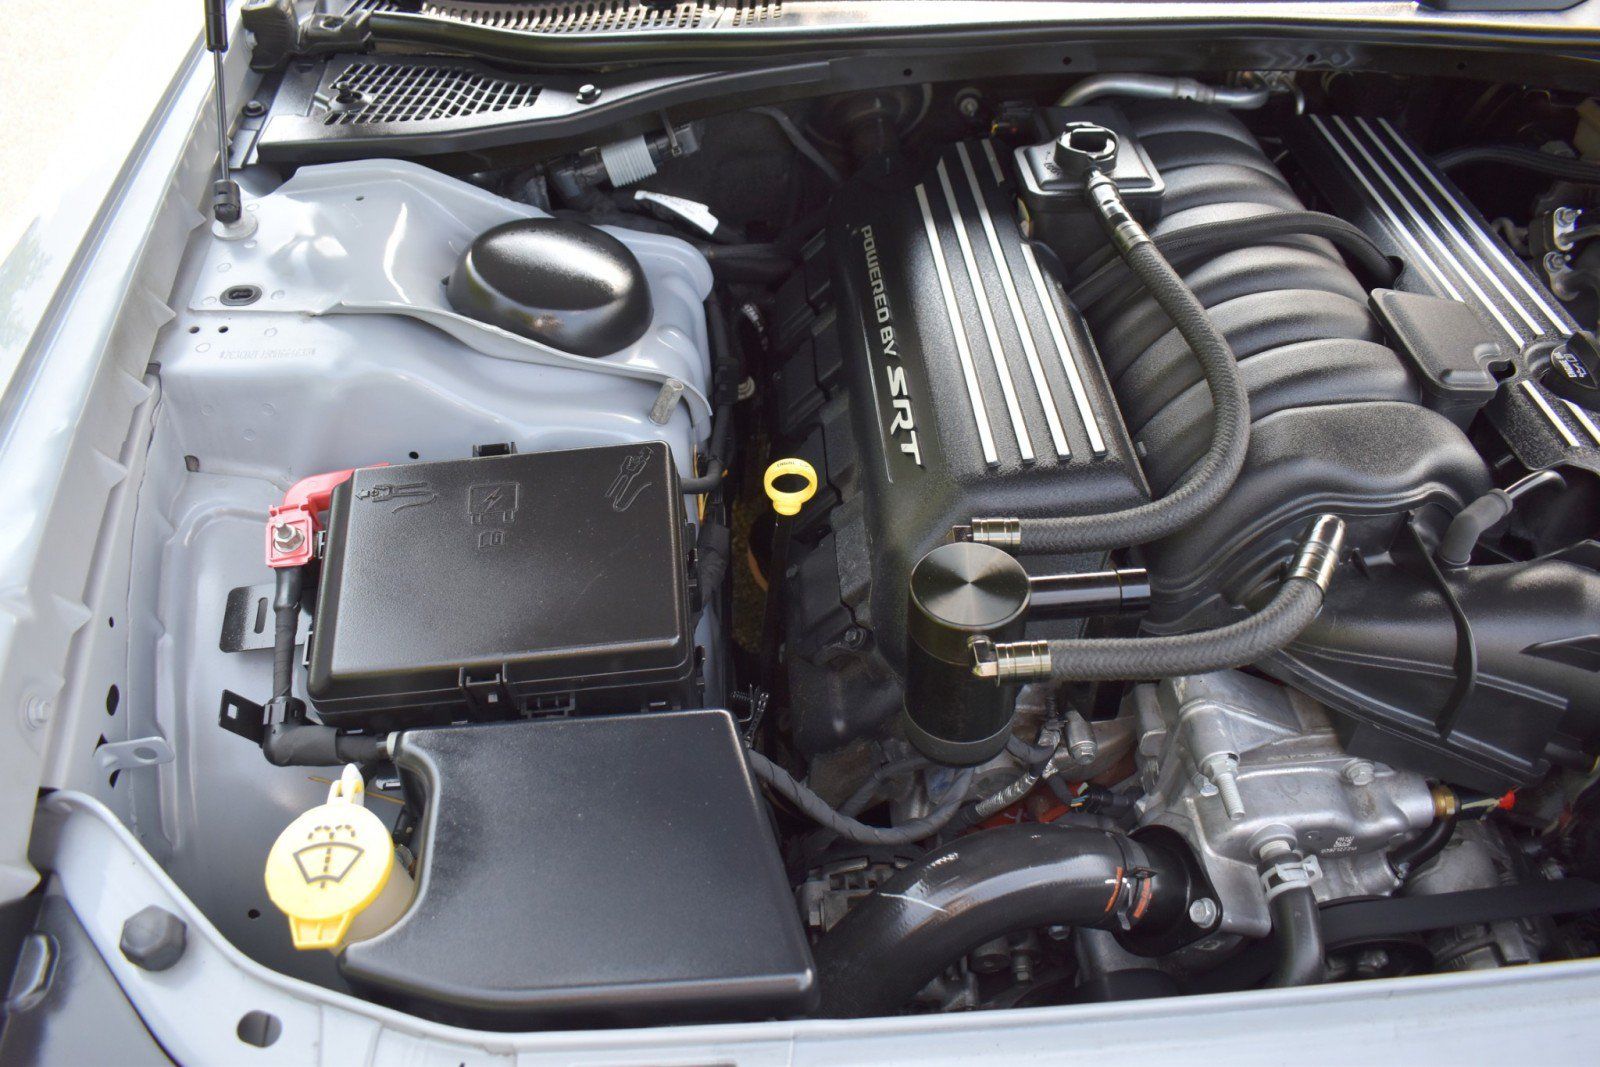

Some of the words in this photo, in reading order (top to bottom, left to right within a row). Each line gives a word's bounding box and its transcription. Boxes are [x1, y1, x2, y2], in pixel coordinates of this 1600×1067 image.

[861, 224, 890, 323] POWERED
[880, 325, 898, 356] BY
[886, 365, 922, 466] SRT
